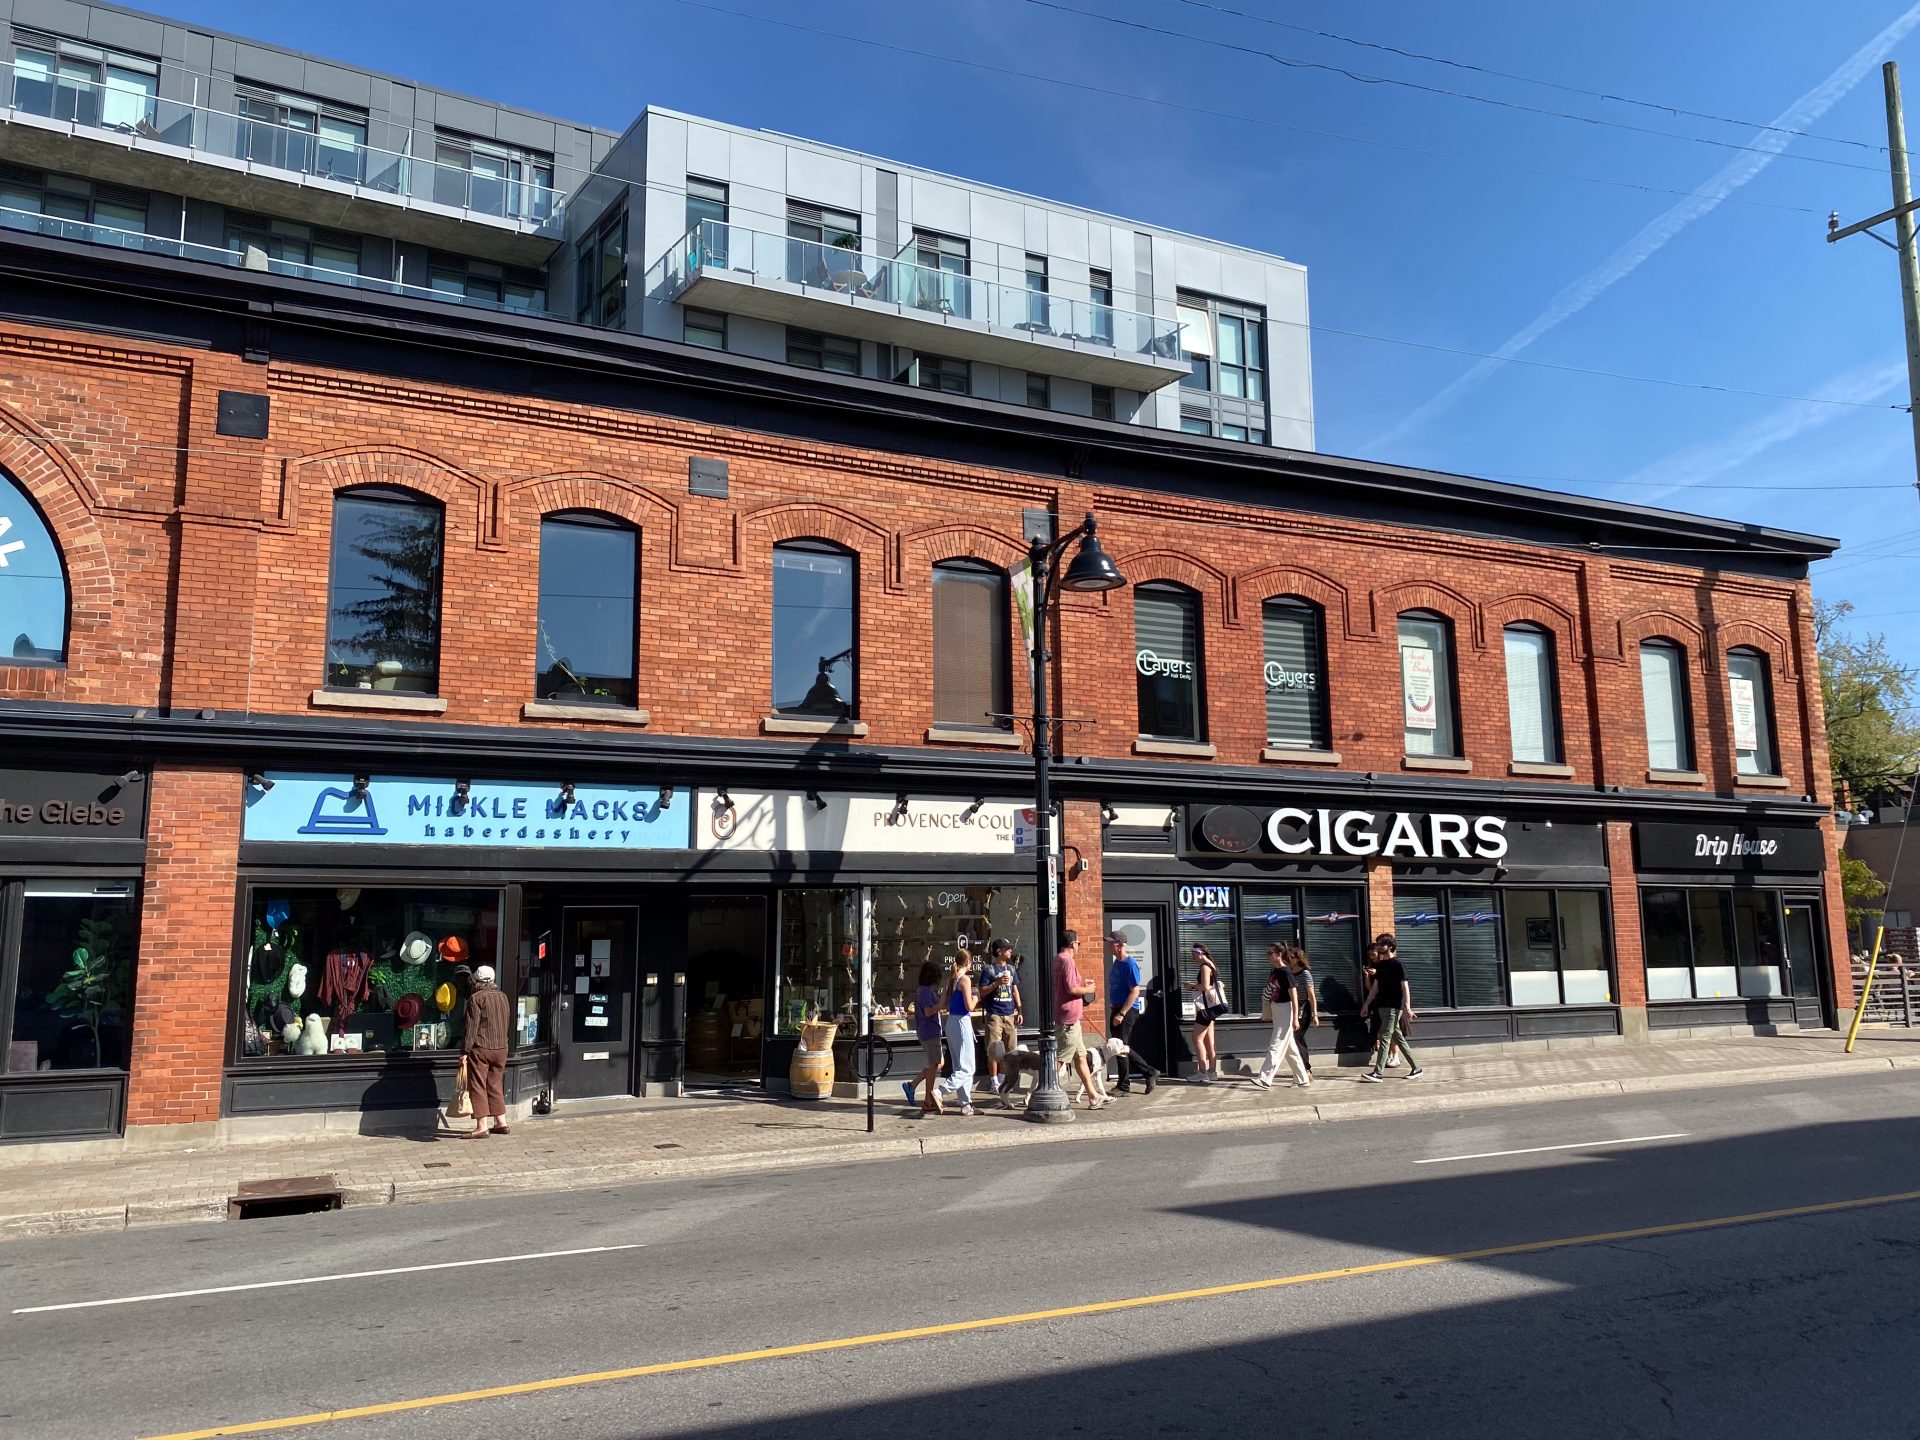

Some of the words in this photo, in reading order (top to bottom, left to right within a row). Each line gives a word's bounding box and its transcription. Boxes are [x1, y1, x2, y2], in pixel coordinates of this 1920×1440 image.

[1139, 651, 1192, 677] Layers
[1266, 662, 1316, 687] Layers
[0, 799, 34, 823] he
[40, 799, 125, 825] Glebe
[408, 794, 528, 819] MICKLE
[545, 797, 649, 822] MACKS
[873, 811, 961, 829] PROVENCE
[965, 817, 974, 826] EN
[978, 814, 1013, 829] COU
[424, 824, 631, 843] haberdashery
[996, 833, 1009, 841] THE
[1267, 807, 1508, 859] CIGARS
[1695, 833, 1728, 865] Drip
[1731, 833, 1778, 856] House
[938, 891, 968, 909] Open
[1179, 885, 1230, 908] OPEN
